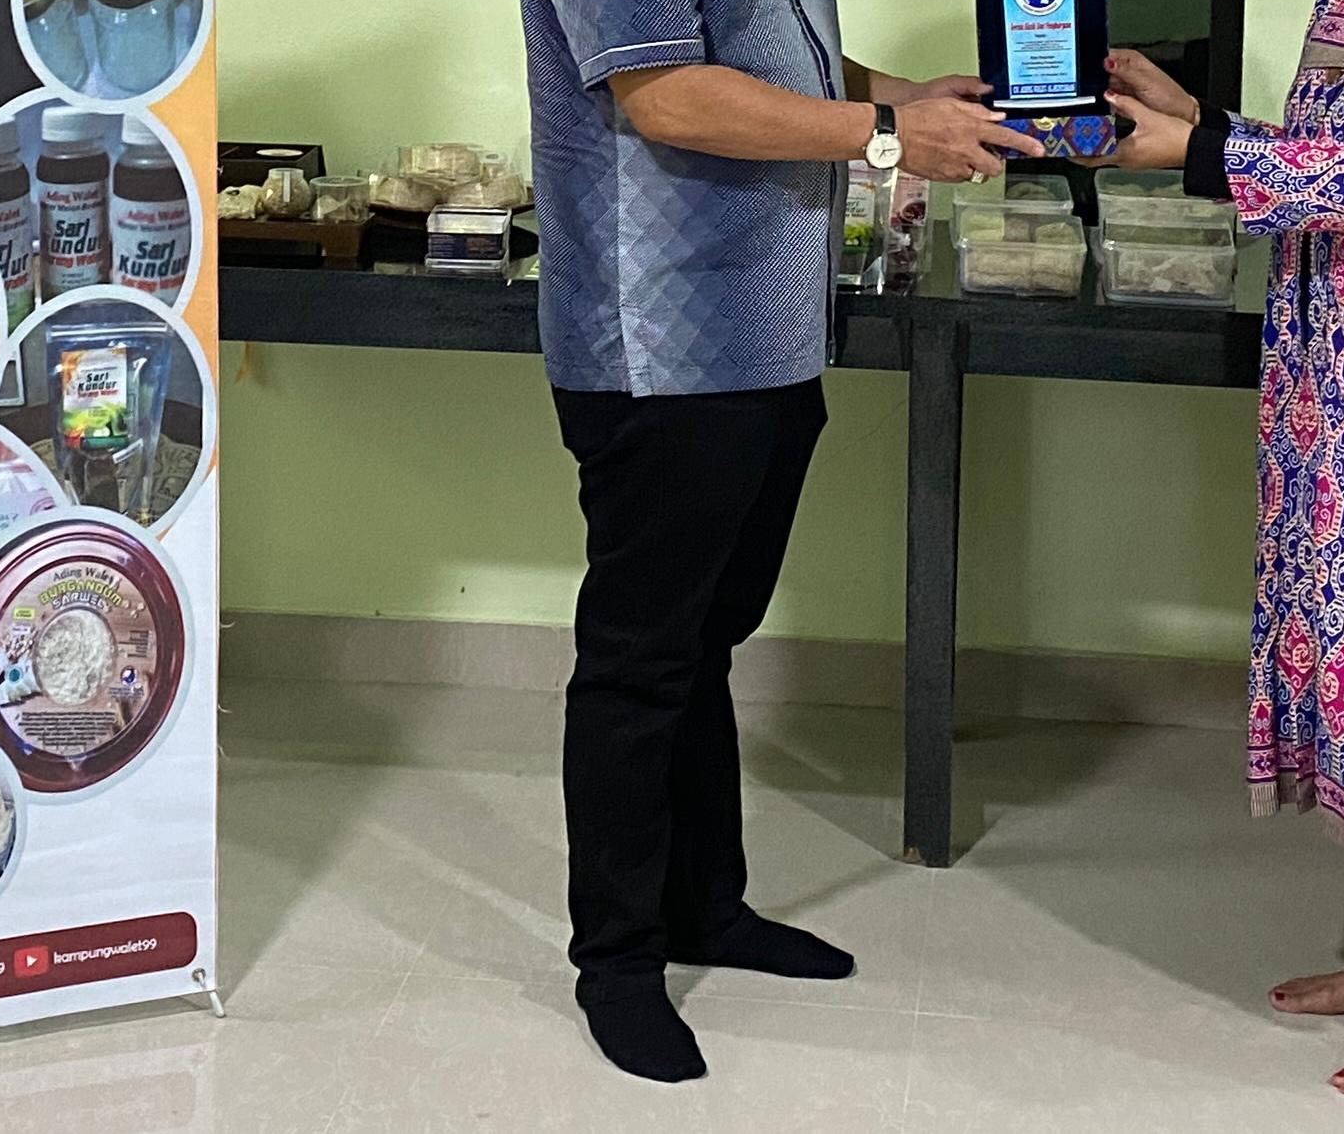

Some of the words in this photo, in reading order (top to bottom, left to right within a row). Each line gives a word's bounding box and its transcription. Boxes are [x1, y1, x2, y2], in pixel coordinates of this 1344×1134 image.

[135, 240, 175, 260] Sari
[86, 371, 109, 383] Sari
[78, 380, 118, 392] Kundur
[53, 938, 158, 965] kampungwalet99
